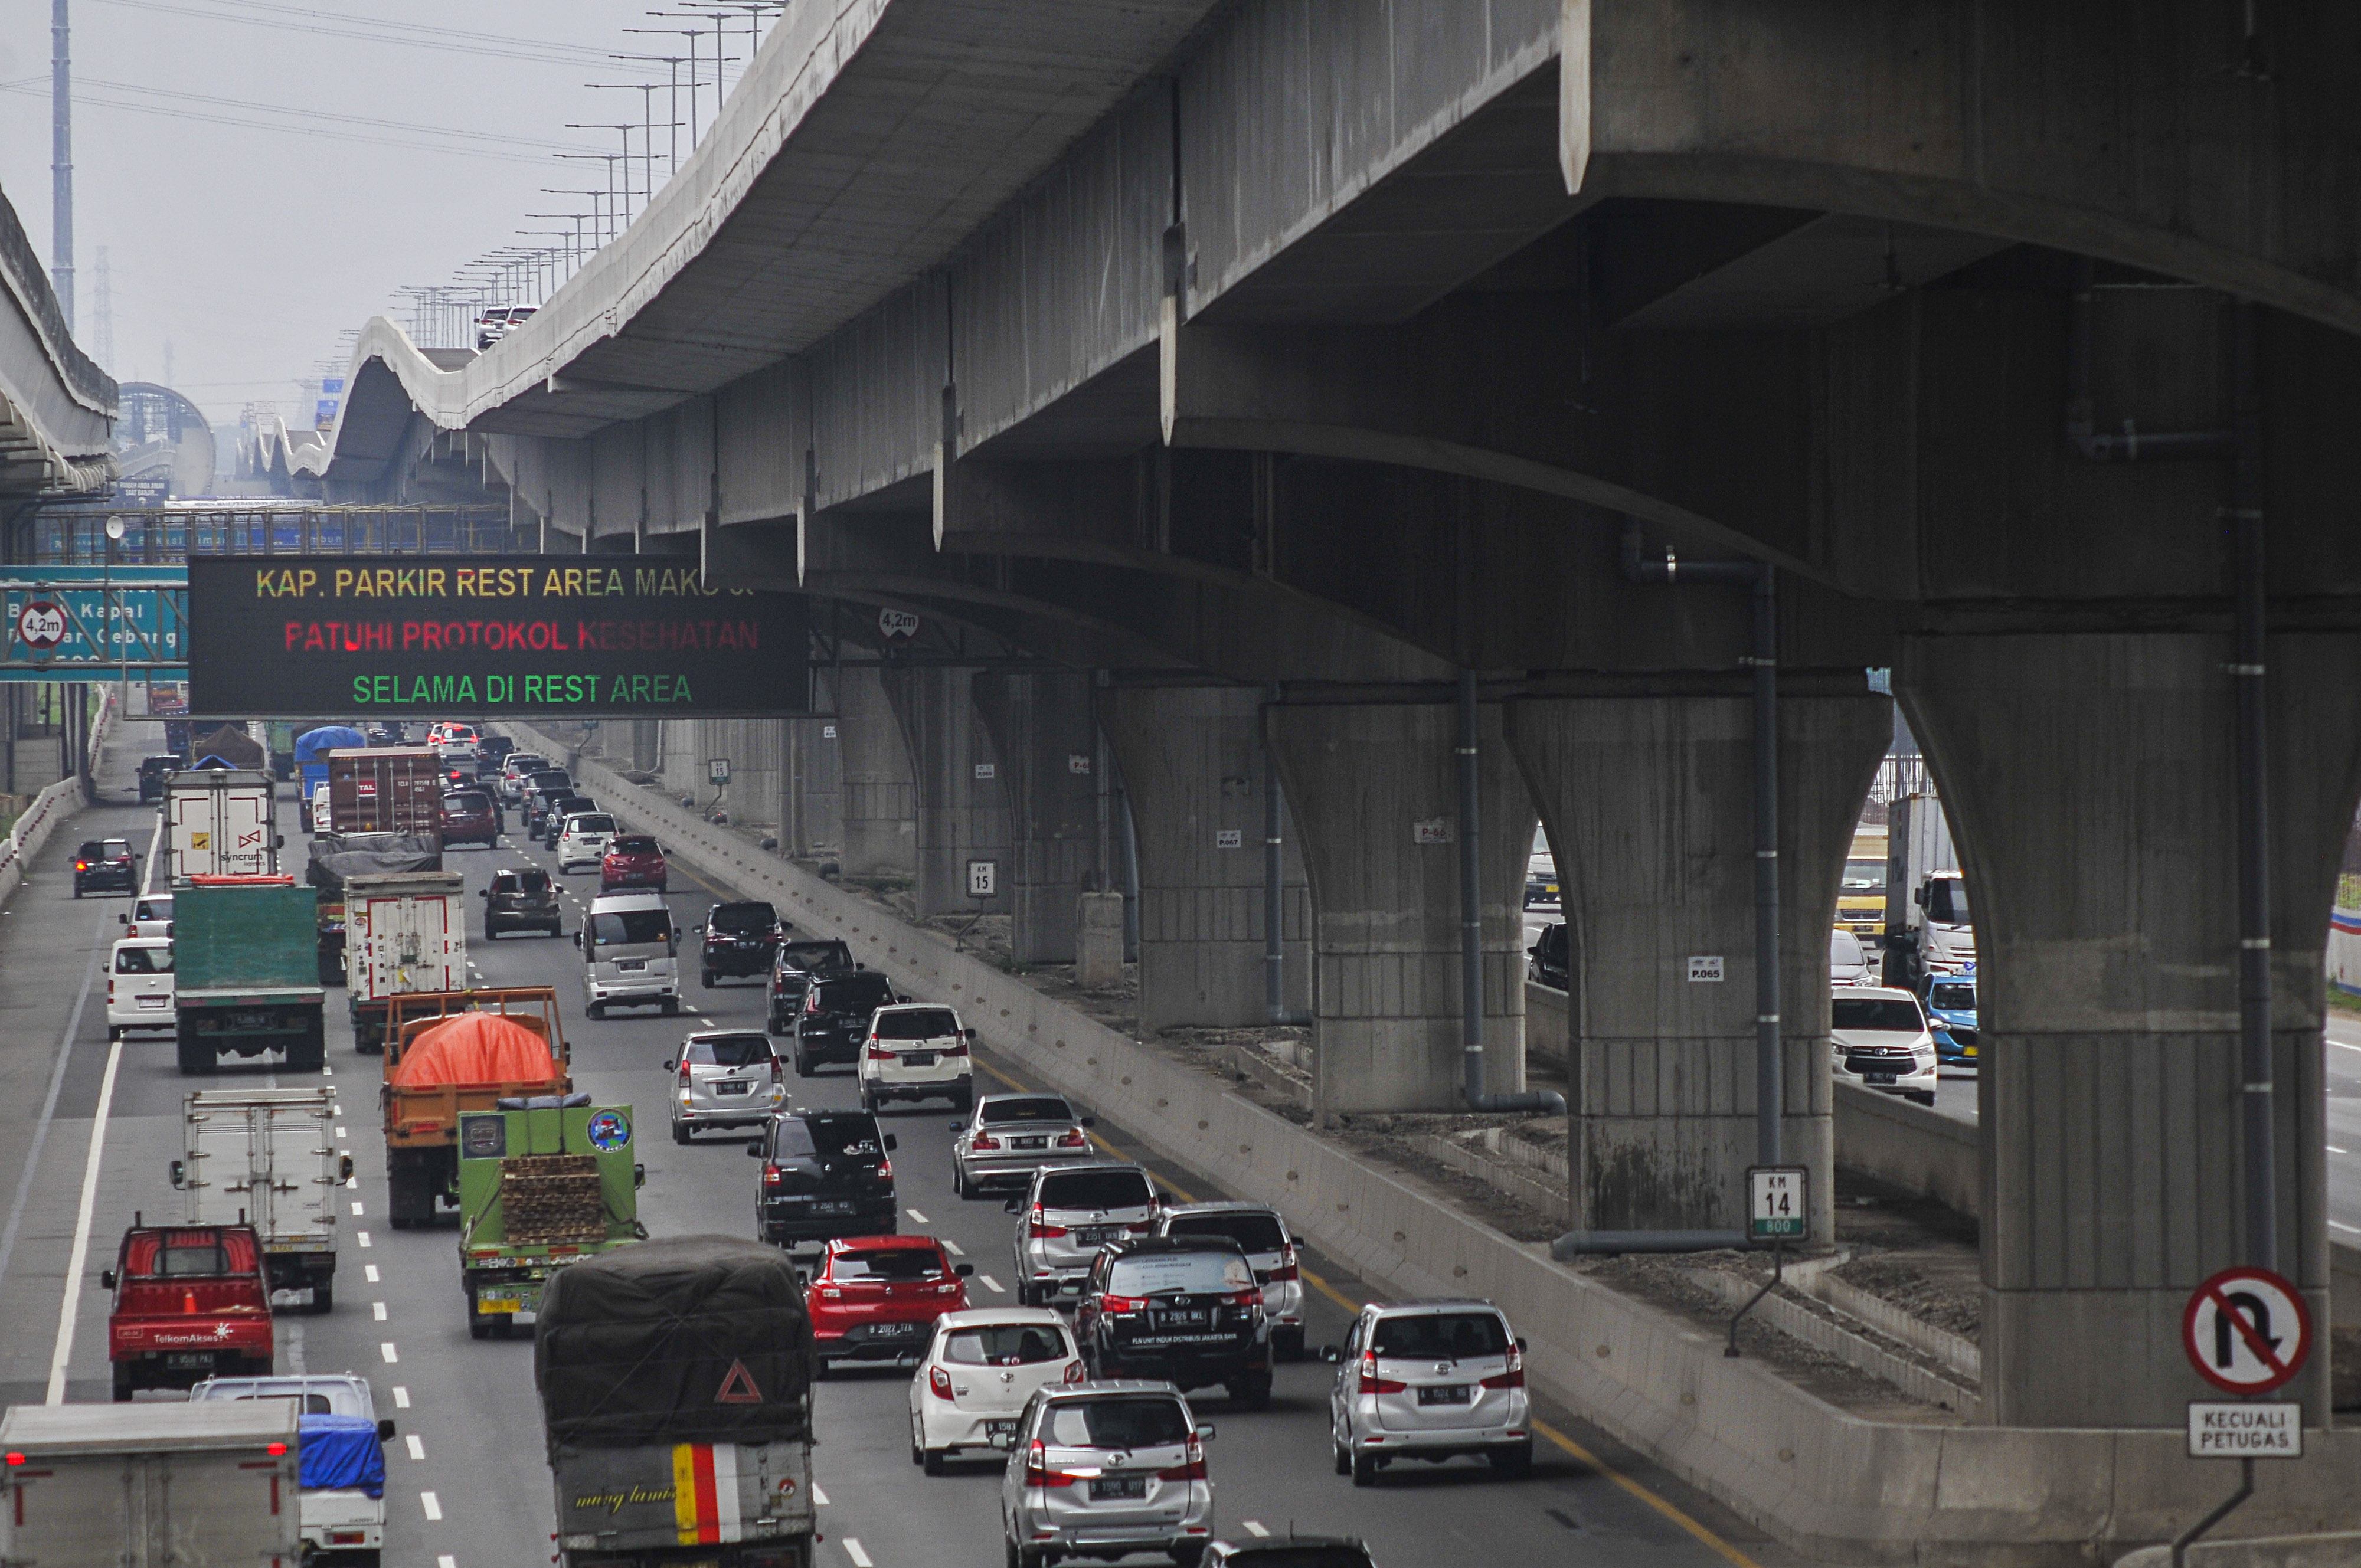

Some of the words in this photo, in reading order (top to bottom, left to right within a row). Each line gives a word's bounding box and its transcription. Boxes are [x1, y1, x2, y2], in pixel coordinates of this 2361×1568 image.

[257, 569, 324, 597] KAP.
[335, 569, 447, 597] PARKIR
[457, 568, 534, 597] REST
[542, 568, 624, 597] AREA
[81, 604, 142, 620] Kapal
[25, 618, 59, 634] 4,2m
[882, 613, 915, 628] 4,2m
[285, 621, 393, 650] PATUHI
[403, 621, 568, 650] PROTOKOL
[578, 621, 758, 650] KESEHATAN
[353, 675, 477, 703] SELAMA
[487, 675, 513, 703] DI
[525, 675, 601, 703] REST
[610, 675, 692, 703] AREA
[221, 853, 263, 863] syncrum
[976, 876, 989, 889] 15
[1692, 970, 1720, 978] P.065
[1768, 1176, 1787, 1189] KM
[1765, 1192, 1791, 1217] 14
[1766, 1220, 1791, 1233] 800
[870, 1325, 875, 1334] B
[878, 1323, 896, 1333] 2022
[153, 1334, 218, 1343] TelkomAkses
[1156, 1335, 1172, 1344] INDUK
[1173, 1334, 1201, 1343] DISTRIBUSI
[1201, 1334, 1223, 1342] JAKARTA
[2205, 1411, 2286, 1429] KECUALI
[988, 1423, 993, 1432] B
[2202, 1432, 2290, 1449] PETUGAS
